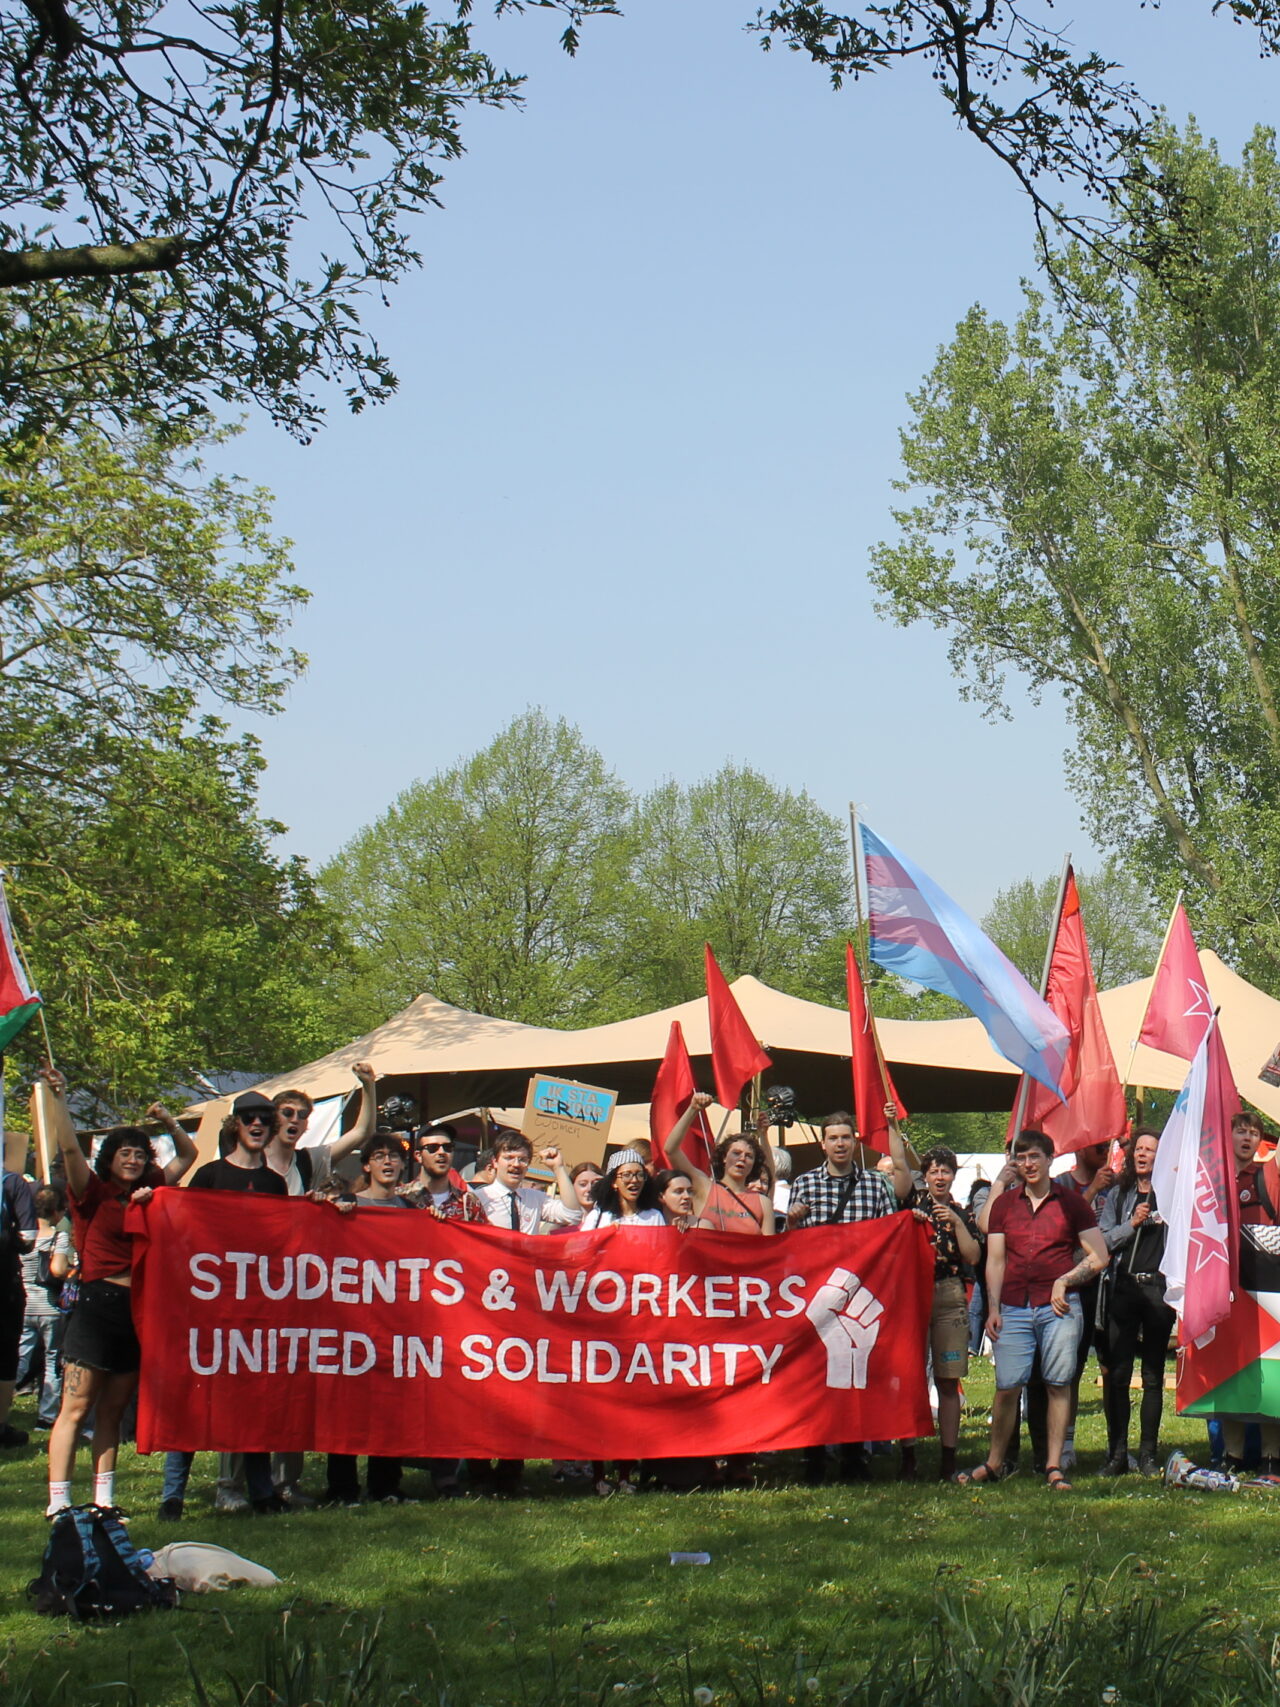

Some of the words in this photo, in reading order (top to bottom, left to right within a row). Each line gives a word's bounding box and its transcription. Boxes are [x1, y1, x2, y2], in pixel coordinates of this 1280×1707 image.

[543, 1097, 600, 1126] IRAN
[547, 1085, 564, 1099] IK
[189, 1252, 465, 1306] STUDENTS
[481, 1268, 517, 1311] &
[534, 1268, 807, 1319] WORKERS
[189, 1327, 377, 1377] UNITED
[392, 1335, 443, 1379] IN
[460, 1334, 784, 1387] SOLIDARITY
